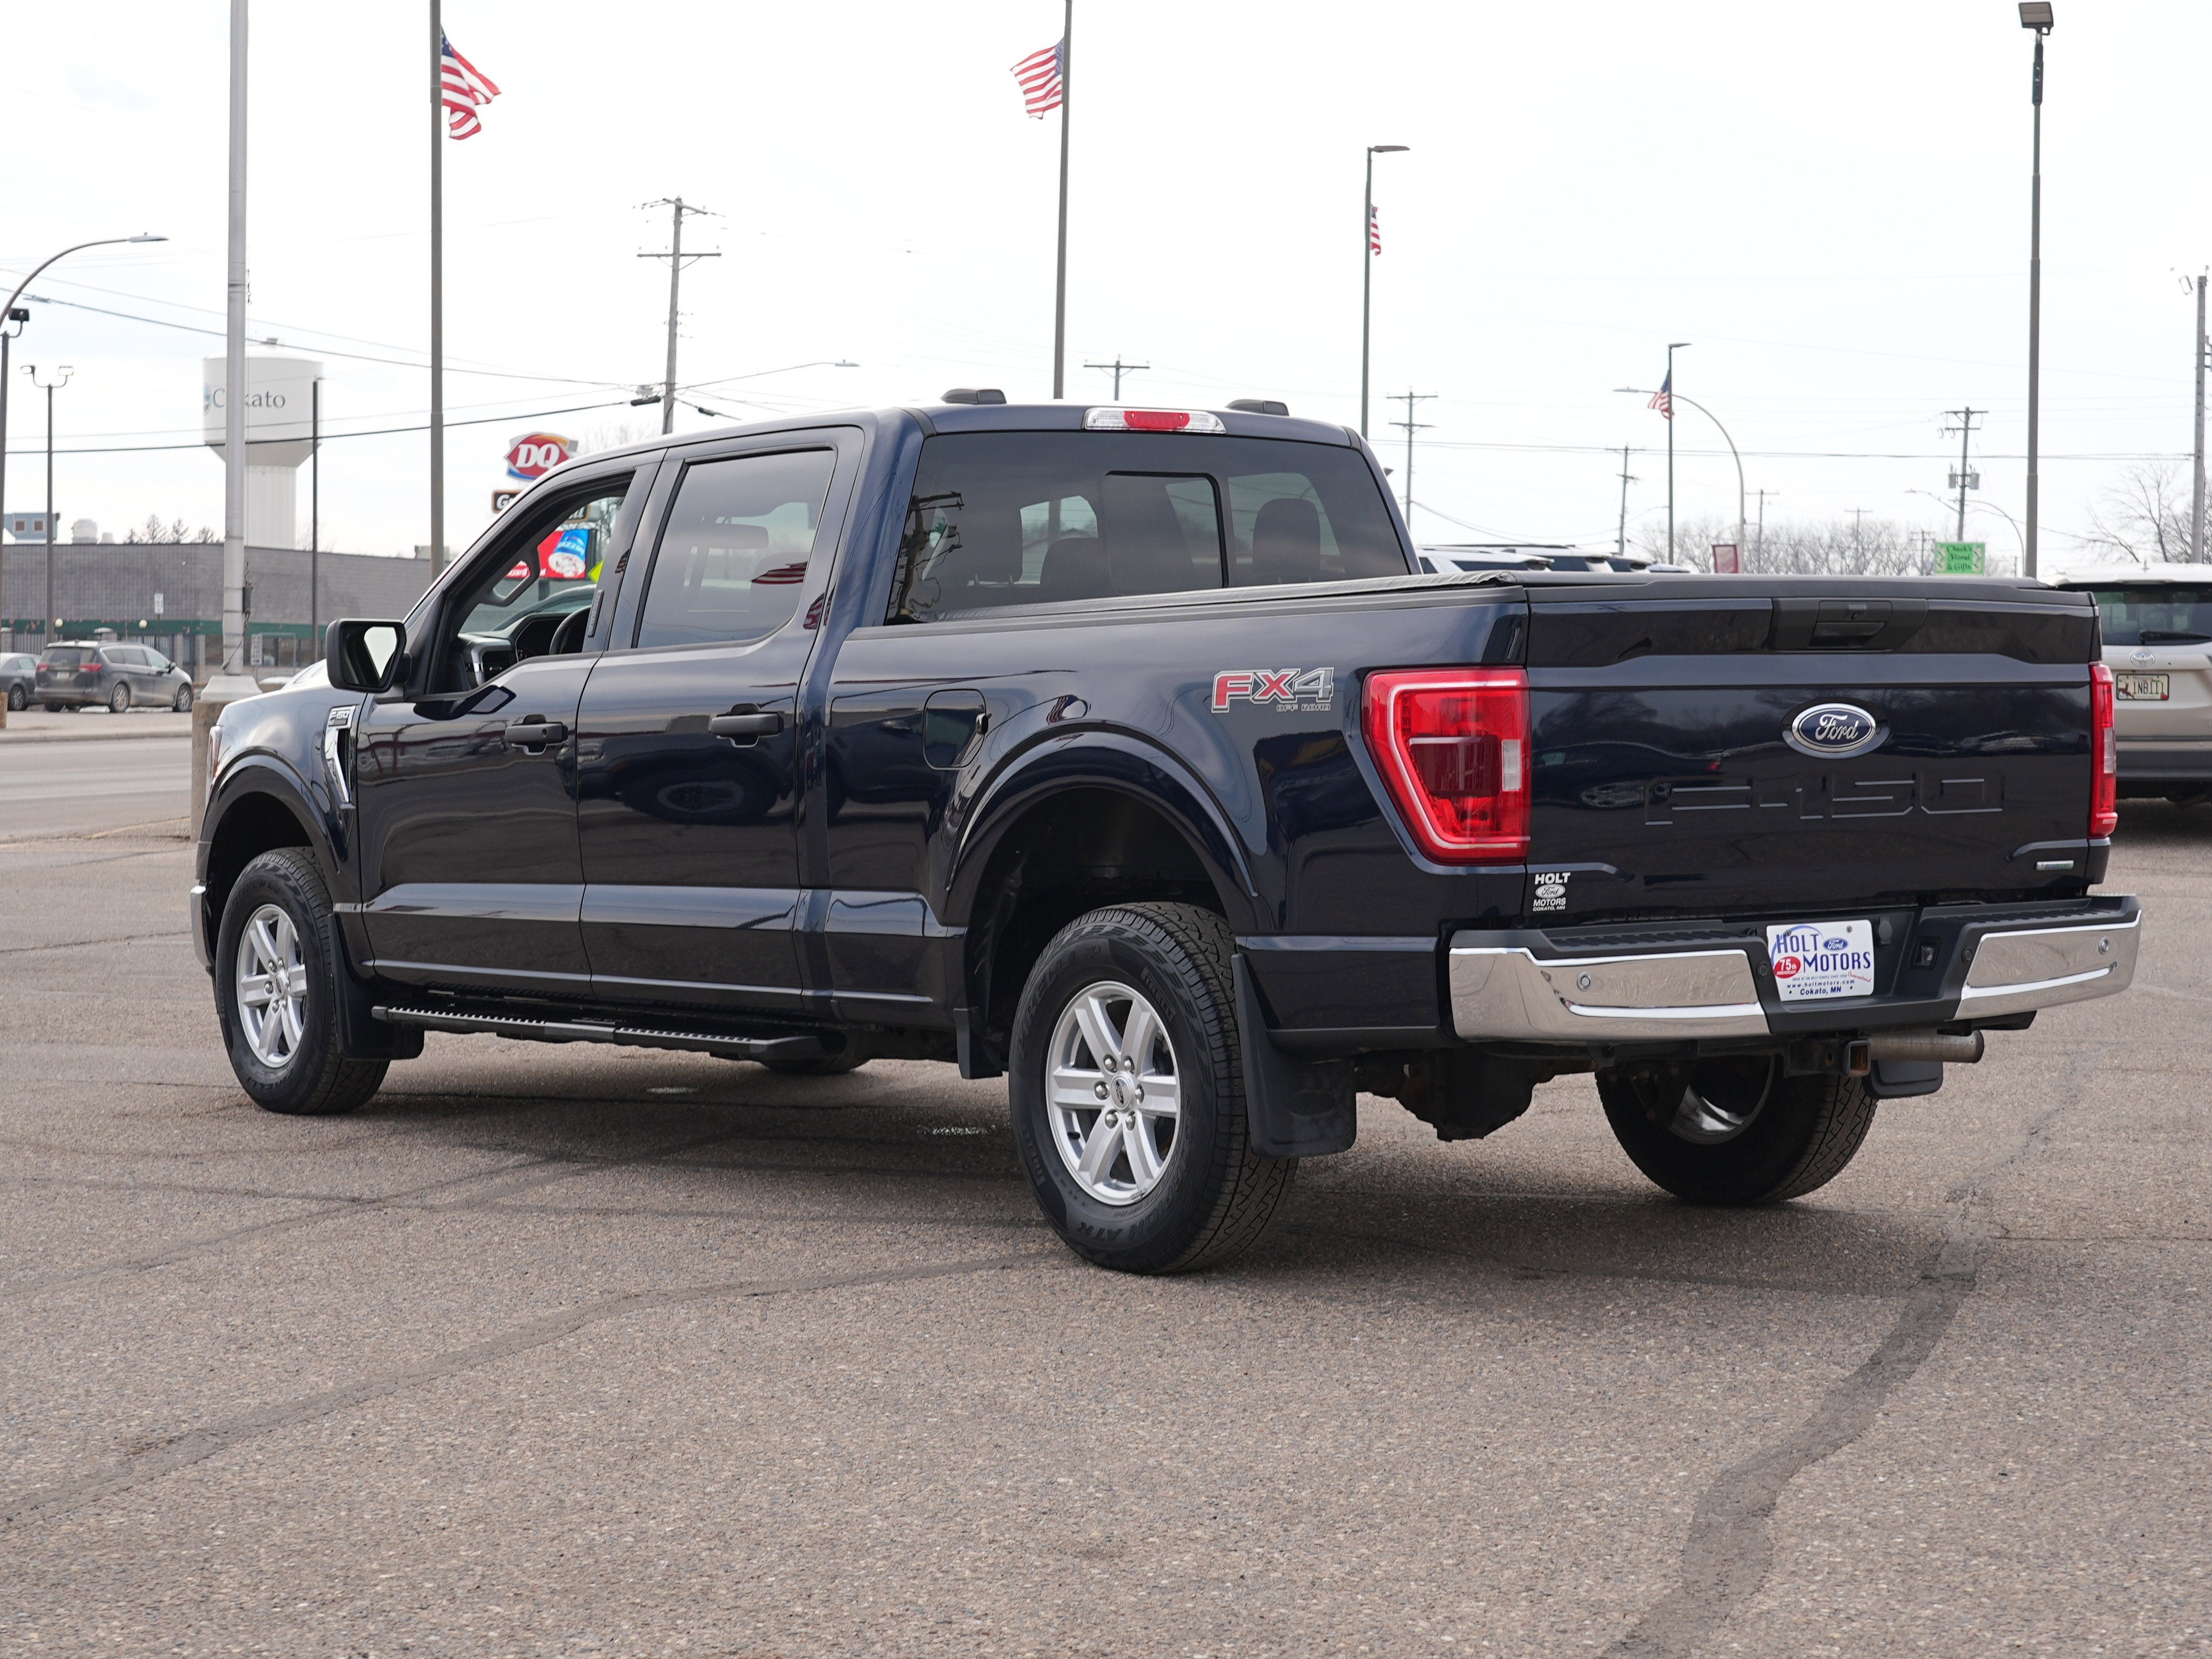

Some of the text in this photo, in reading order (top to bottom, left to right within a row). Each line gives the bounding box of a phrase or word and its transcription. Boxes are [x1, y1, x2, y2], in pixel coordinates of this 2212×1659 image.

[213, 388, 285, 408] Cato
[515, 443, 560, 470] DQ
[1946, 545, 1972, 553] Chuck's
[1946, 562, 1971, 571] & Gifts
[1211, 666, 1334, 713] FX4
[1276, 703, 1331, 712] OFF ROAD
[1815, 713, 1859, 740] Ford
[1644, 771, 2005, 826] F-150
[1534, 872, 1571, 885] HOLT
[1533, 897, 1566, 907] MOTORS
[1776, 934, 1819, 953] HOLT
[1779, 958, 1797, 971] 75th
[1803, 952, 1871, 973] MOTORS
[1786, 979, 1855, 989] www.holtmotors.com
